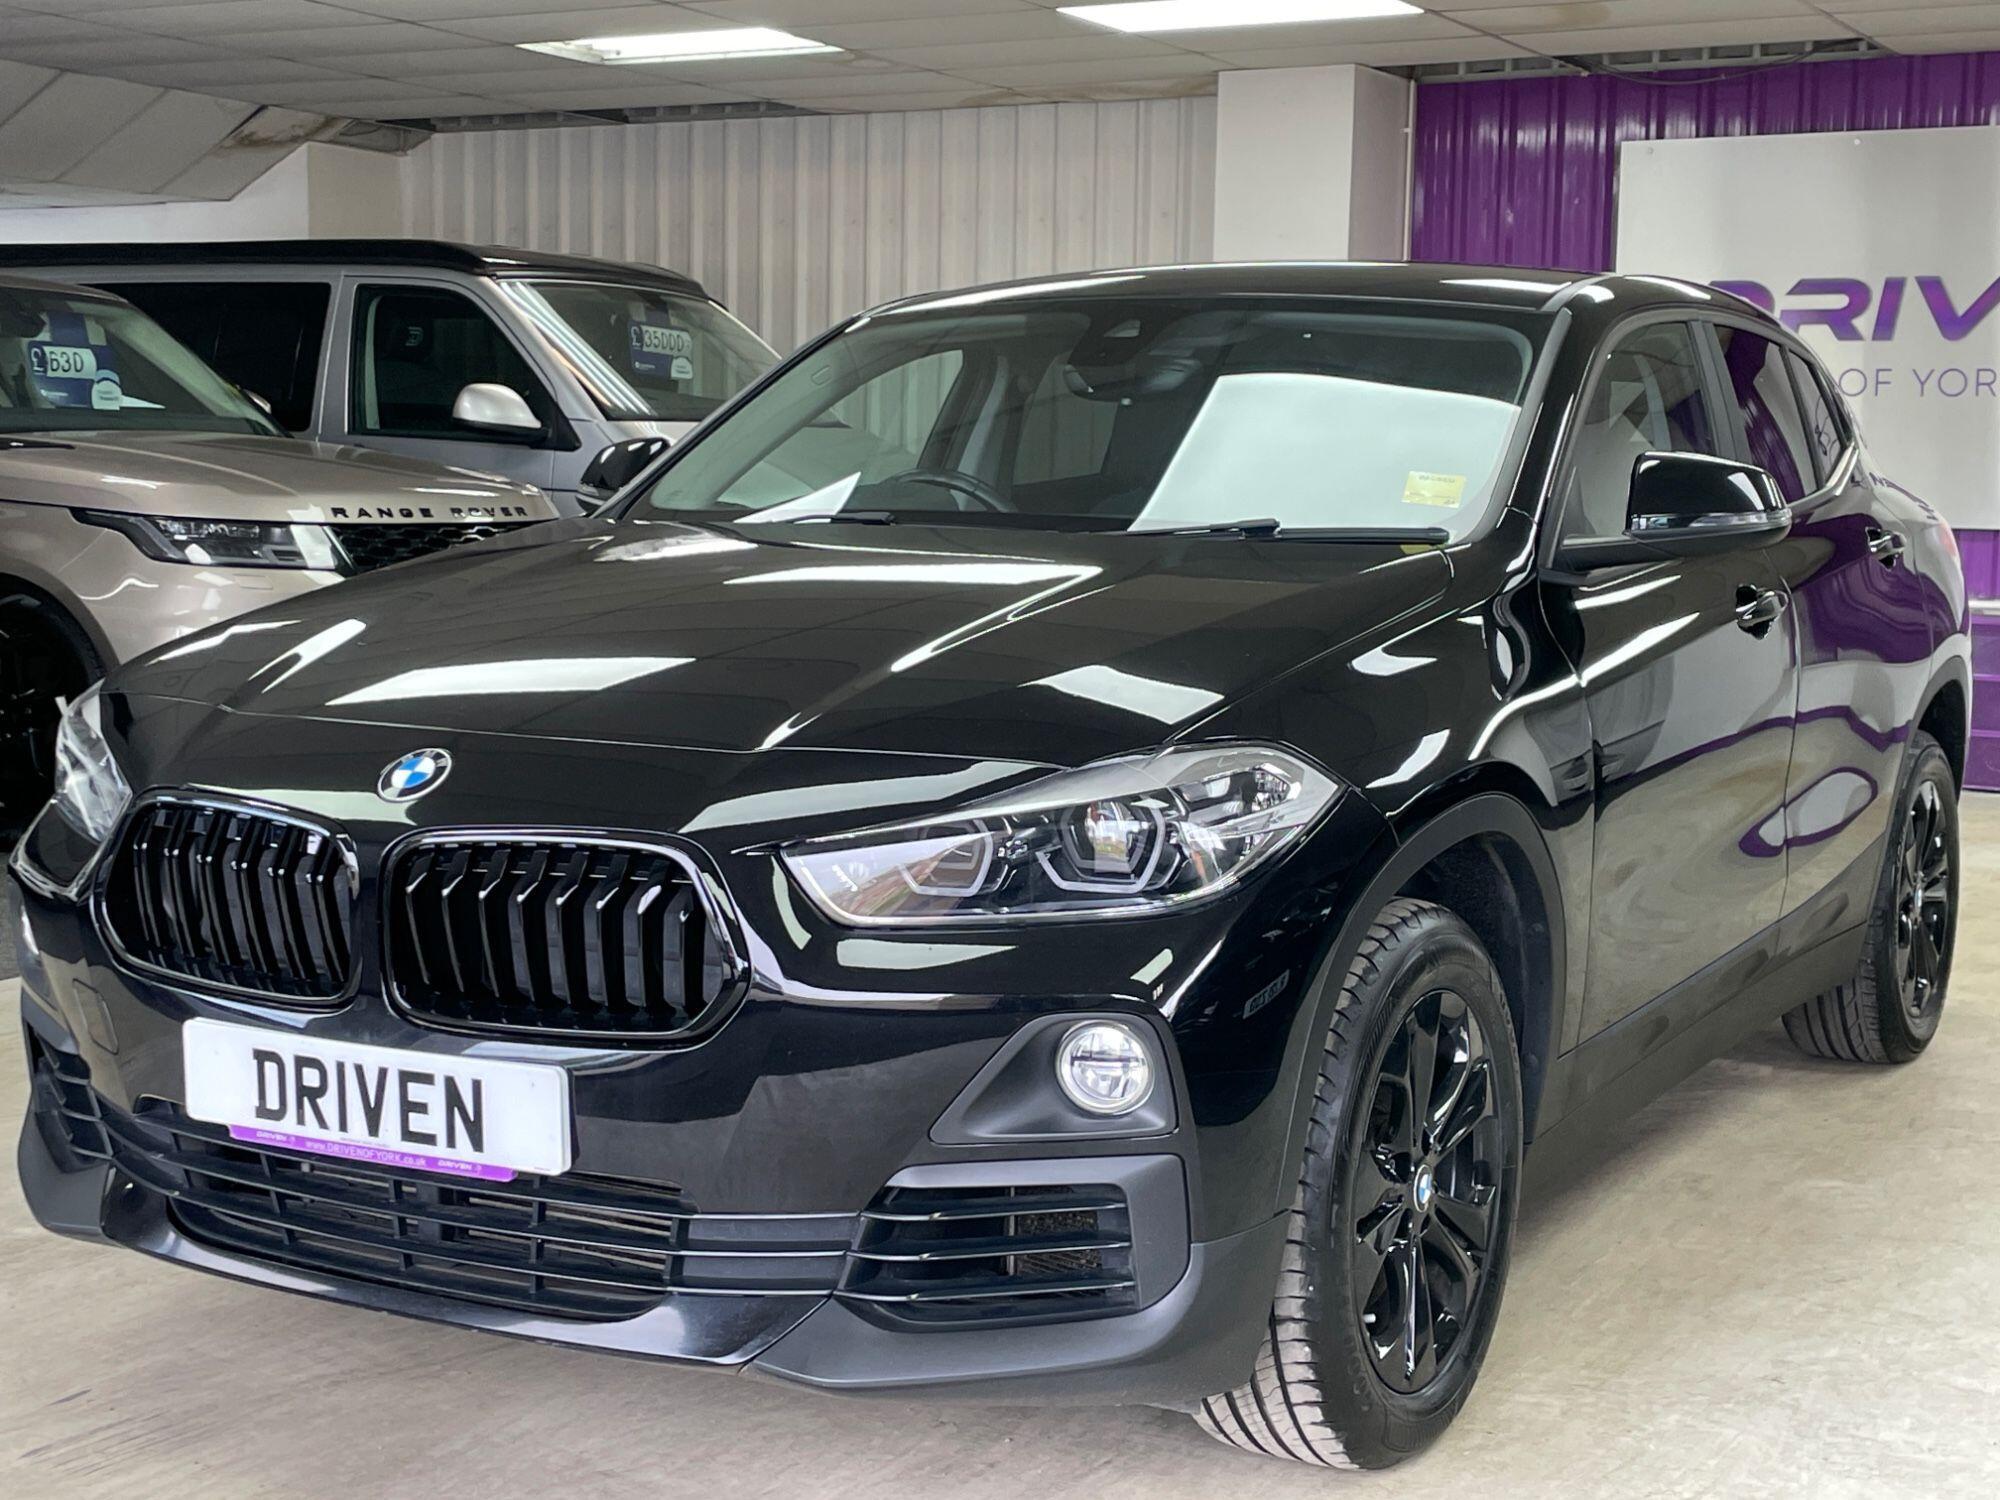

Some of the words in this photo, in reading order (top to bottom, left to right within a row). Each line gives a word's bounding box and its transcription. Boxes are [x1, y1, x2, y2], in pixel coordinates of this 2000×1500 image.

[1838, 368, 1893, 397] OF
[1912, 368, 1997, 397] YOR
[331, 507, 434, 518] RANGE
[450, 506, 528, 518] ROVER
[252, 1048, 484, 1153] DRIVEN
